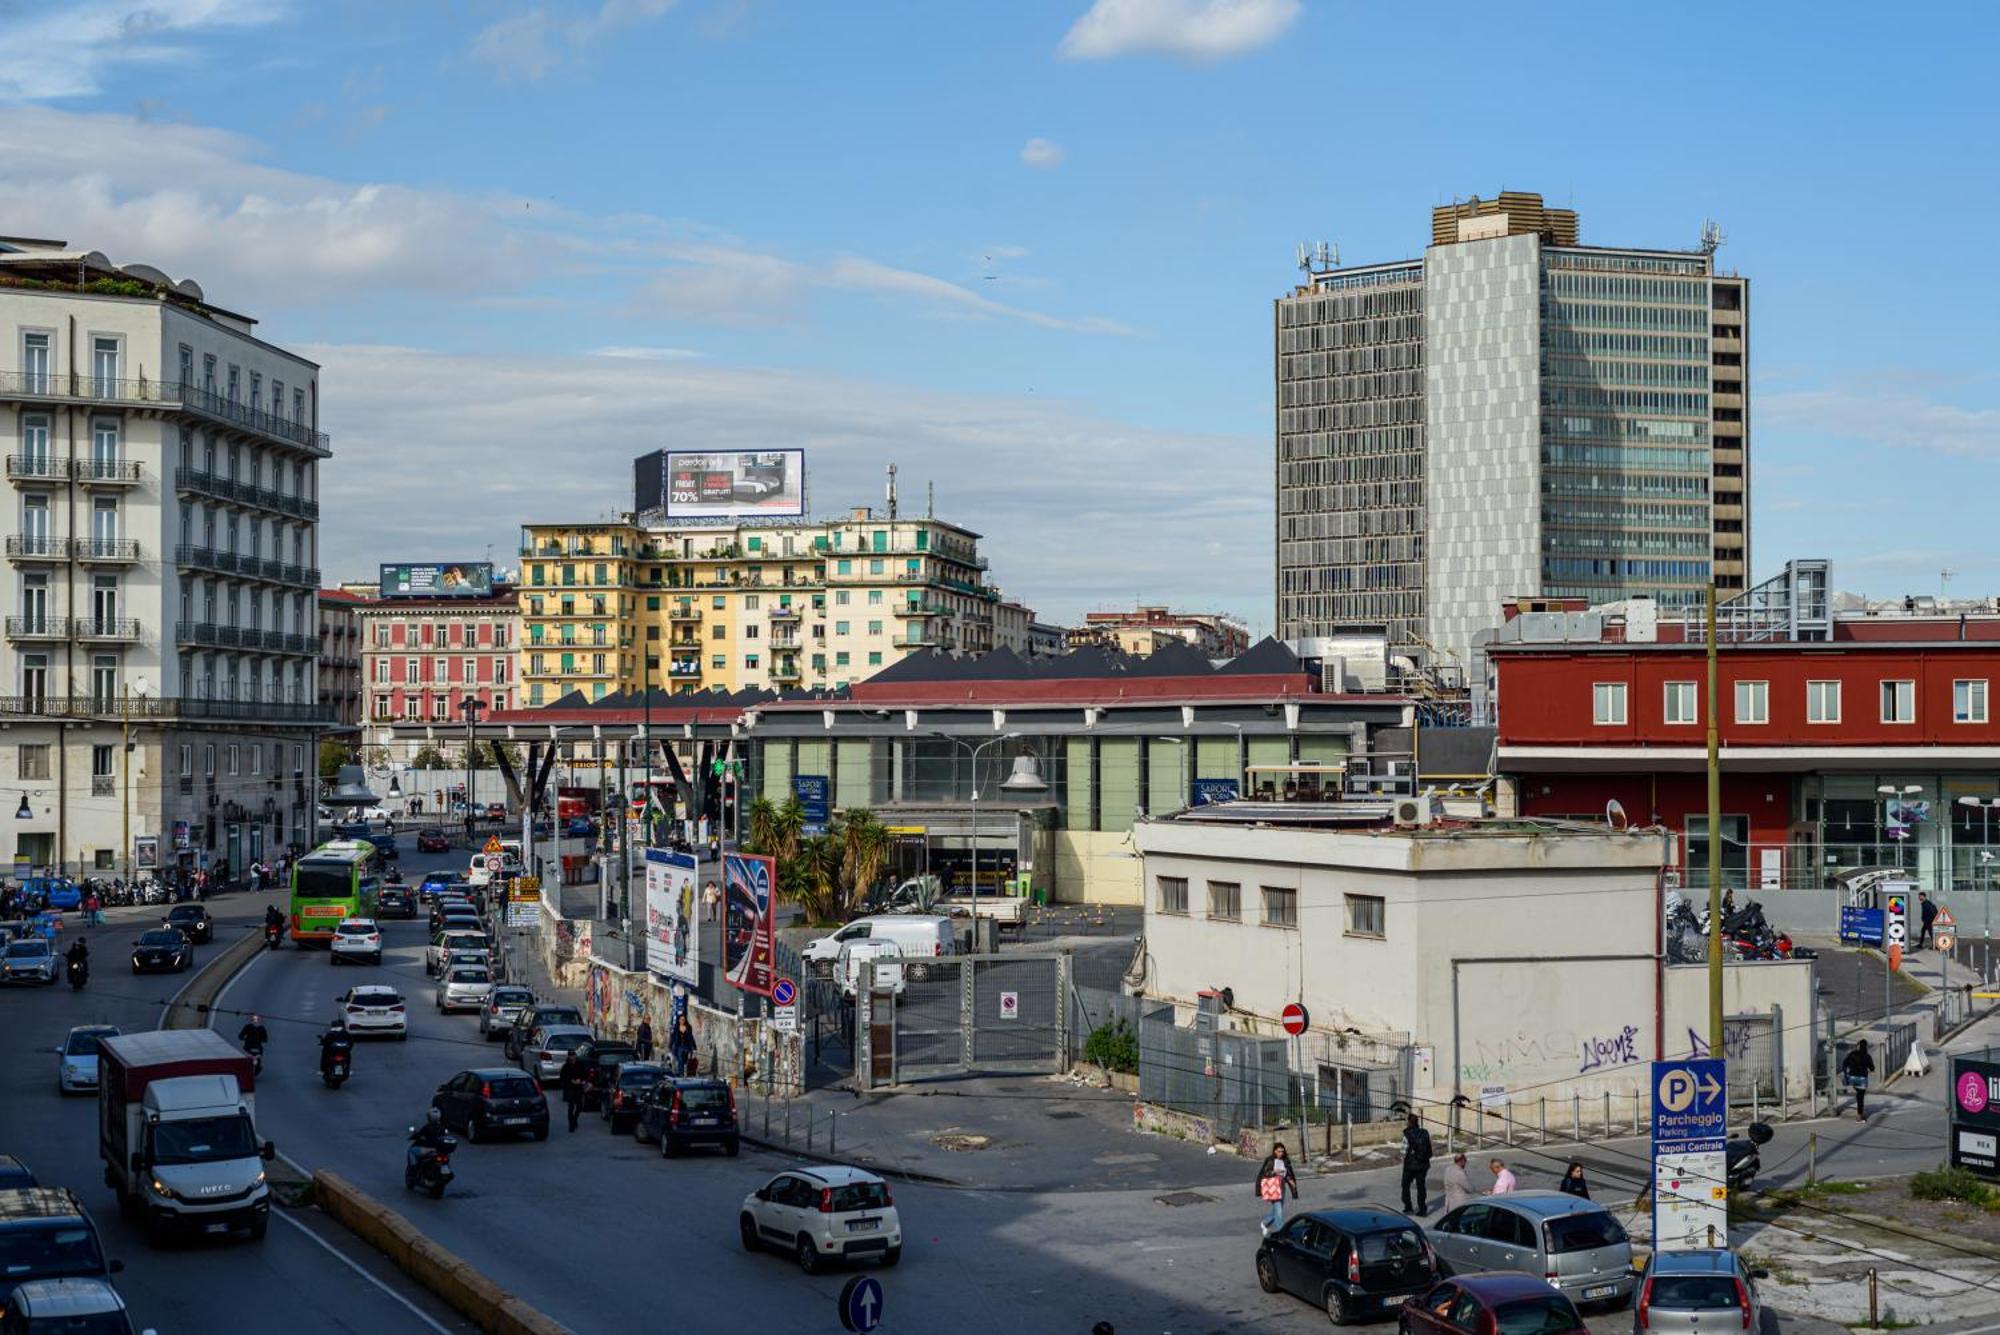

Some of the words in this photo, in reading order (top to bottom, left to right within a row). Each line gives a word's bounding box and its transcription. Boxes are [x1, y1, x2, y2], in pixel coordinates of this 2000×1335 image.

[672, 491, 698, 502] 70%
[1670, 1079, 1687, 1105] P
[1659, 1112, 1723, 1126] Parcheggio
[1659, 1128, 1688, 1137] Parking
[1658, 1144, 1686, 1154] Napoli
[1687, 1141, 1724, 1152] Centrale
[200, 1184, 232, 1193] IVECO
